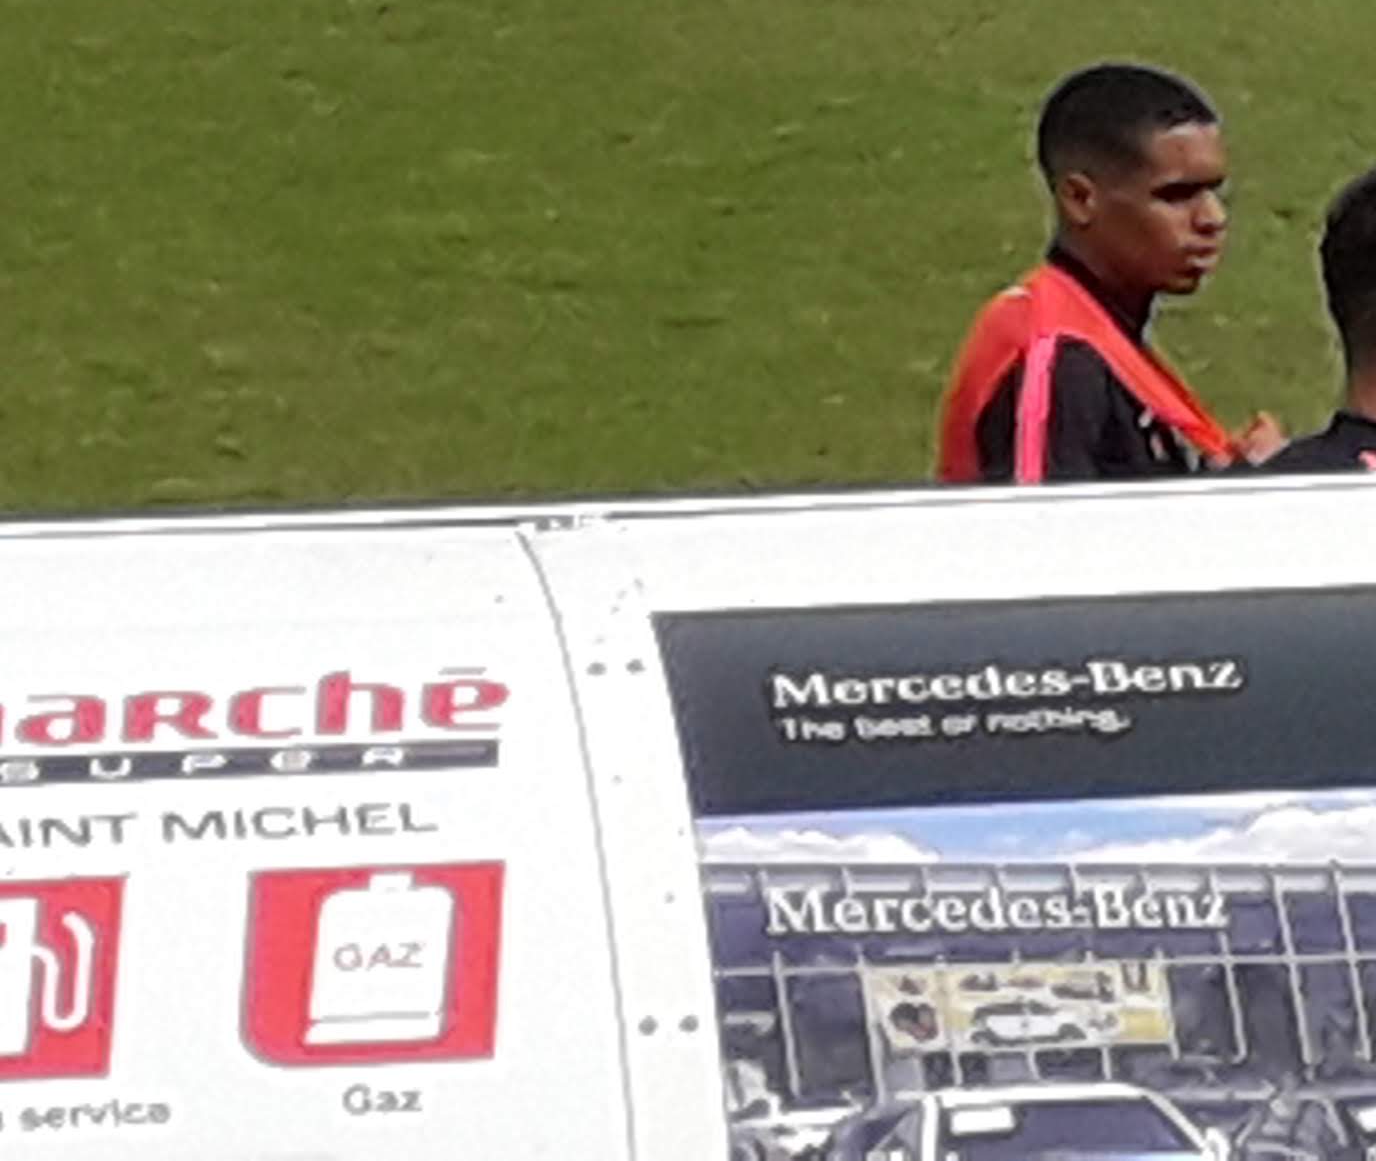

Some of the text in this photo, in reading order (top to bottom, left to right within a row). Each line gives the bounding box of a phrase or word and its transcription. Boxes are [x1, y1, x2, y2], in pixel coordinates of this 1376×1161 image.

[772, 659, 1243, 708] Mercedes-Benz
[0, 669, 510, 747] arché
[780, 717, 845, 741] The
[853, 712, 934, 738] best
[941, 713, 976, 735] or
[162, 803, 438, 843] MICHEL
[766, 886, 1229, 935] Mercedes-Benz
[333, 942, 423, 971] GAZ
[342, 1084, 422, 1115] Gaz
